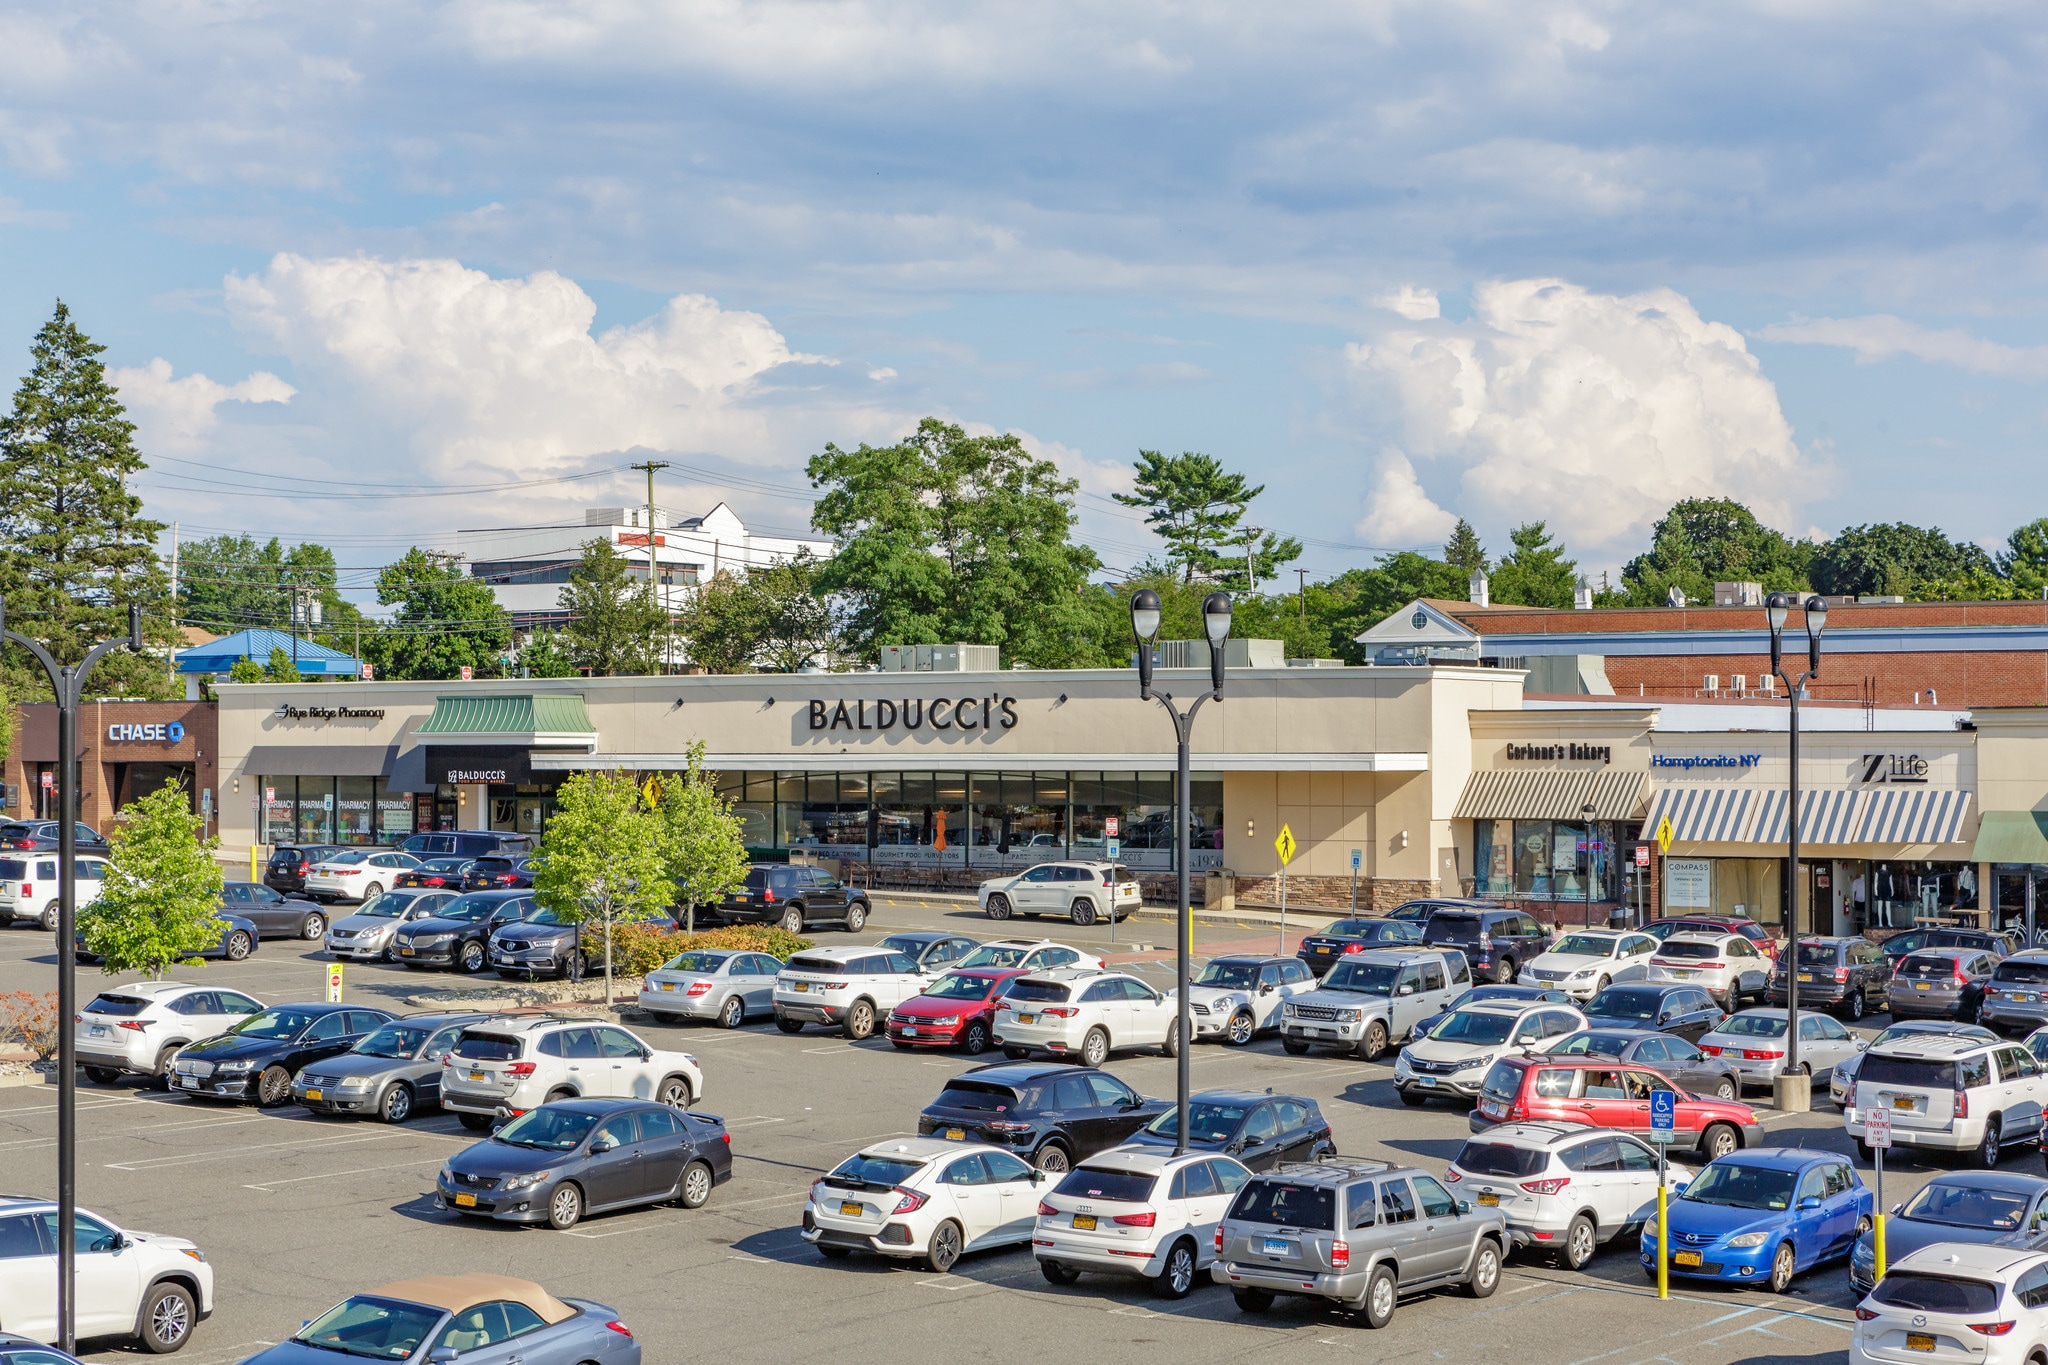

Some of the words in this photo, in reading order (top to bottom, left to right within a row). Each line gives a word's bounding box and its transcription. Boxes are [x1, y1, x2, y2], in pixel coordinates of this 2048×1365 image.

[290, 707, 307, 721] Rye
[309, 706, 337, 721] Ridge
[339, 706, 385, 721] Pharmacy
[809, 693, 1019, 729] BALDUCCI'S
[108, 723, 168, 741] CHASE
[1506, 742, 1565, 760] Cerbone's
[1569, 743, 1611, 765] Bakery
[1652, 755, 1738, 770] Hamptonite
[1740, 755, 1762, 767] NY
[1861, 755, 1887, 783] Z
[1890, 754, 1929, 776] life
[458, 769, 506, 780] BALDUCCI'S
[262, 800, 294, 809] PARMACY
[300, 800, 325, 809] PHARMA
[338, 800, 371, 810] PHARMACY
[377, 801, 411, 810] PHARMACY
[418, 806, 431, 817] FREE
[377, 828, 411, 837] Prescriptions
[876, 851, 905, 859] GOURMET
[1668, 863, 1709, 871] COMPASS
[1872, 1112, 1883, 1120] NO
[1867, 1121, 1889, 1129] PARKING
